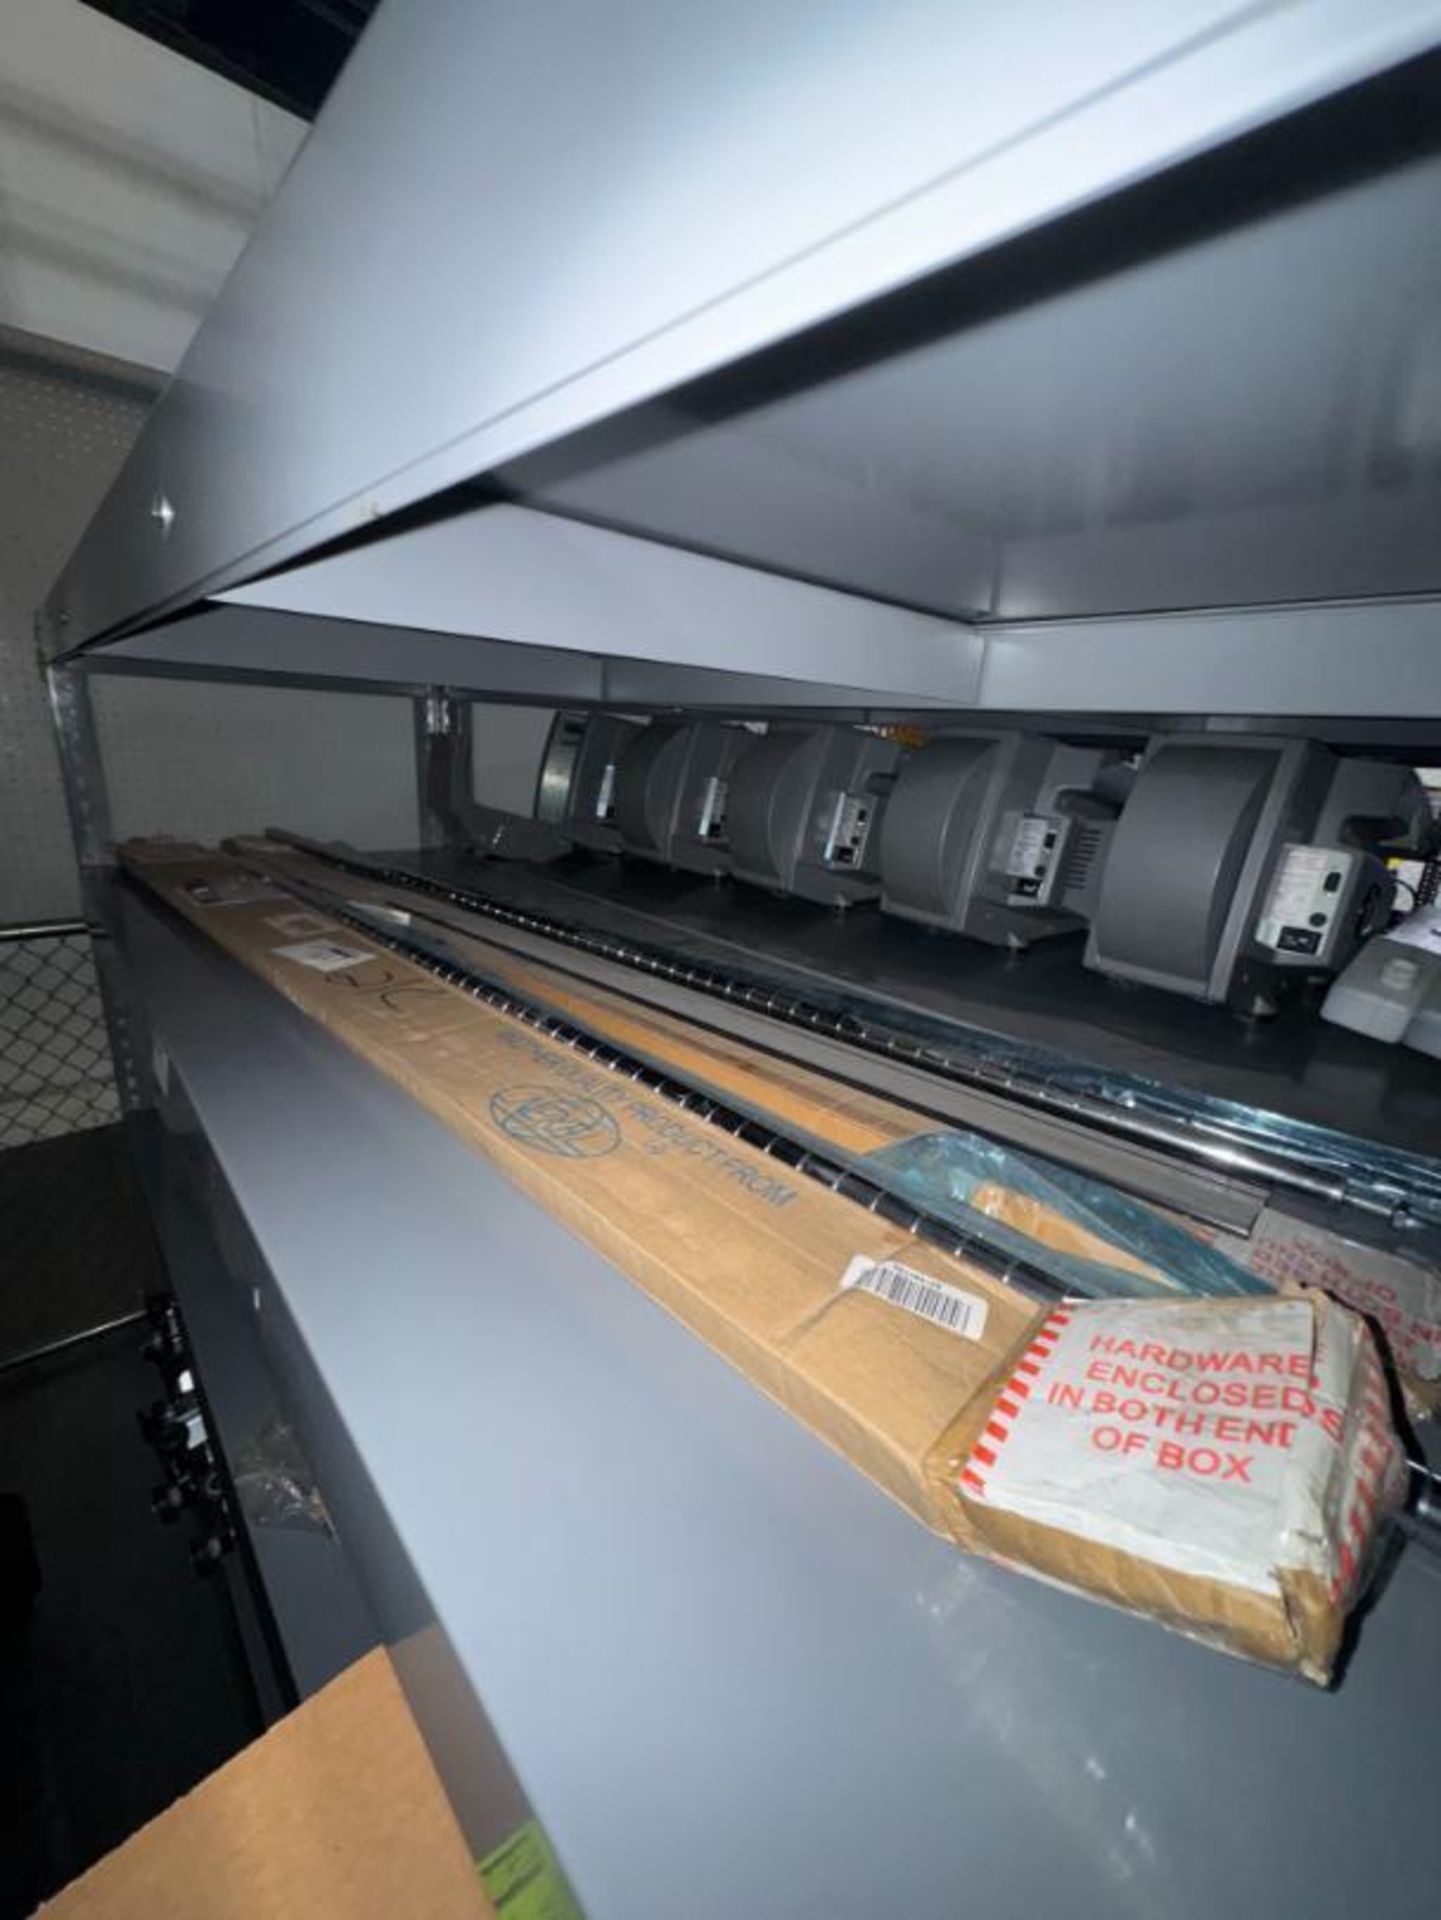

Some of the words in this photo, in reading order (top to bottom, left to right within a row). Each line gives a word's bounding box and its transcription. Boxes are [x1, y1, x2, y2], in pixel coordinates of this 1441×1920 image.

[720, 1154, 798, 1208] FROM
[1089, 1334, 1311, 1378] HARDWARE
[1048, 1382, 1084, 1409] IN
[1092, 1391, 1206, 1436] BOTH
[1086, 1360, 1316, 1416] ENCLOSED
[1091, 1425, 1149, 1453] OF
[1156, 1440, 1254, 1484] BOX
